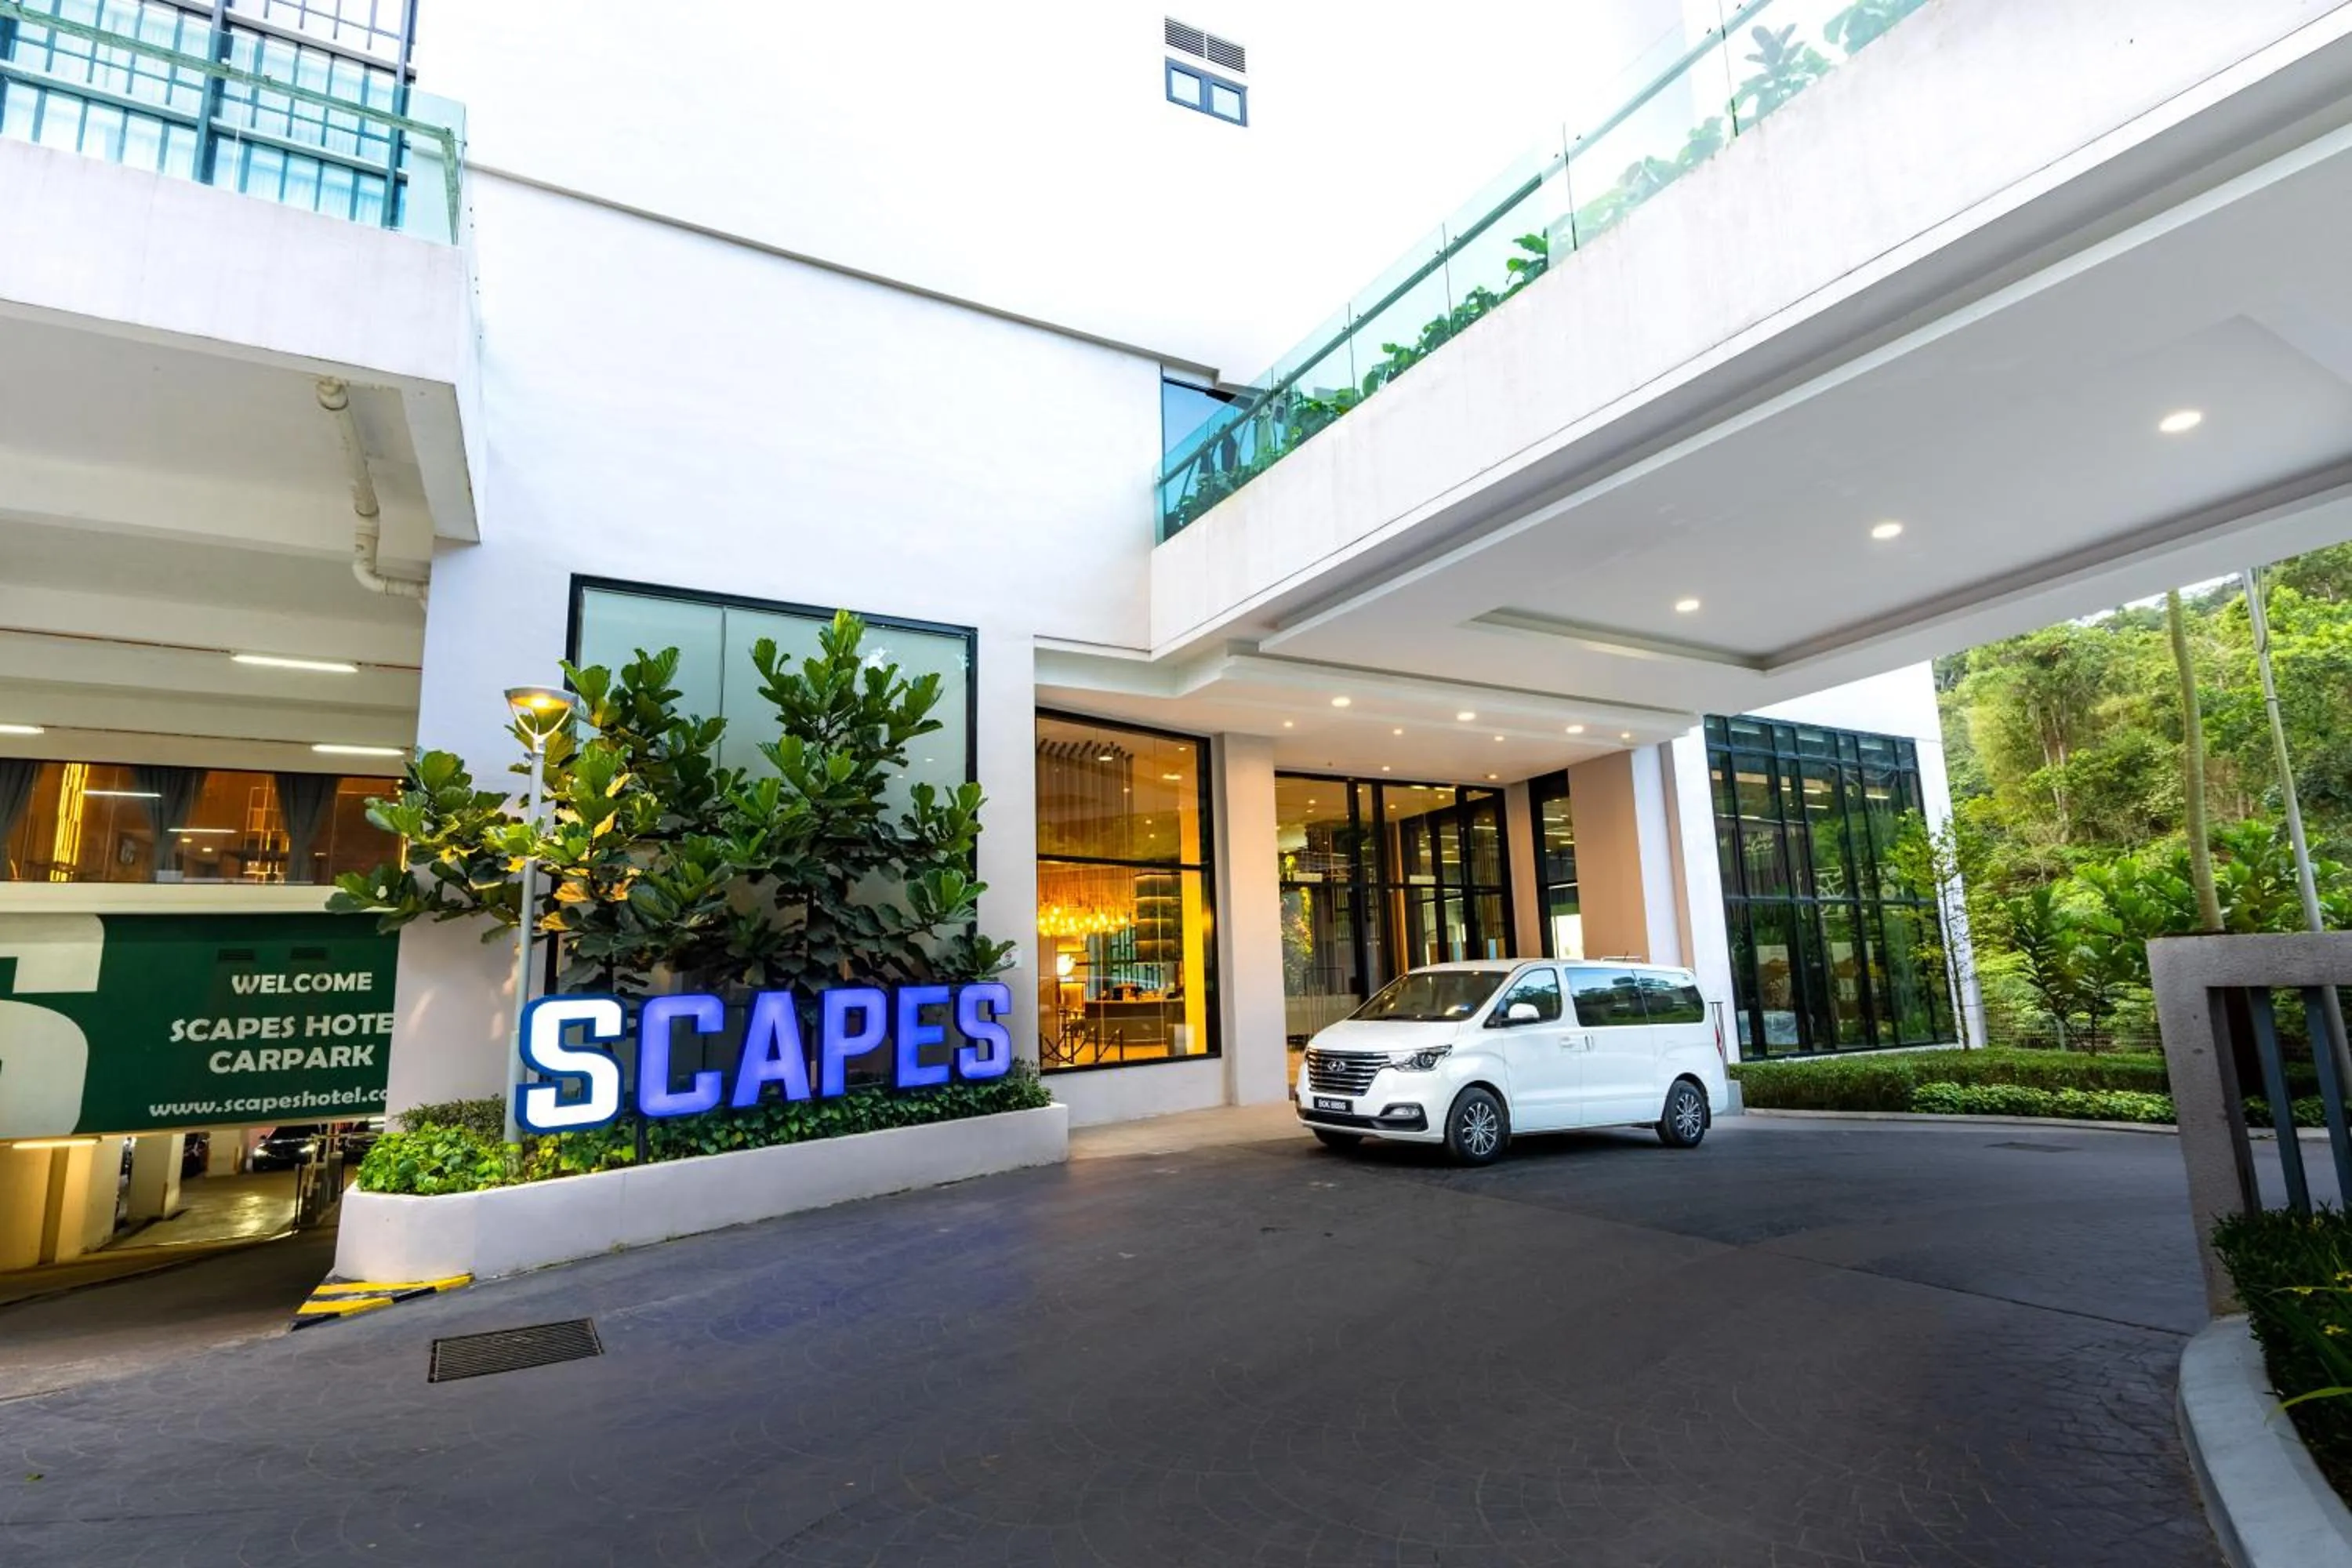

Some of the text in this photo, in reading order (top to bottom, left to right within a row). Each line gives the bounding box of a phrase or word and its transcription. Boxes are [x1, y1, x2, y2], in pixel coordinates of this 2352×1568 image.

[231, 972, 372, 994] WELCOME
[169, 1015, 296, 1043] SCAPES
[209, 1044, 375, 1074] CARPARK
[516, 982, 1012, 1134] SCAPES
